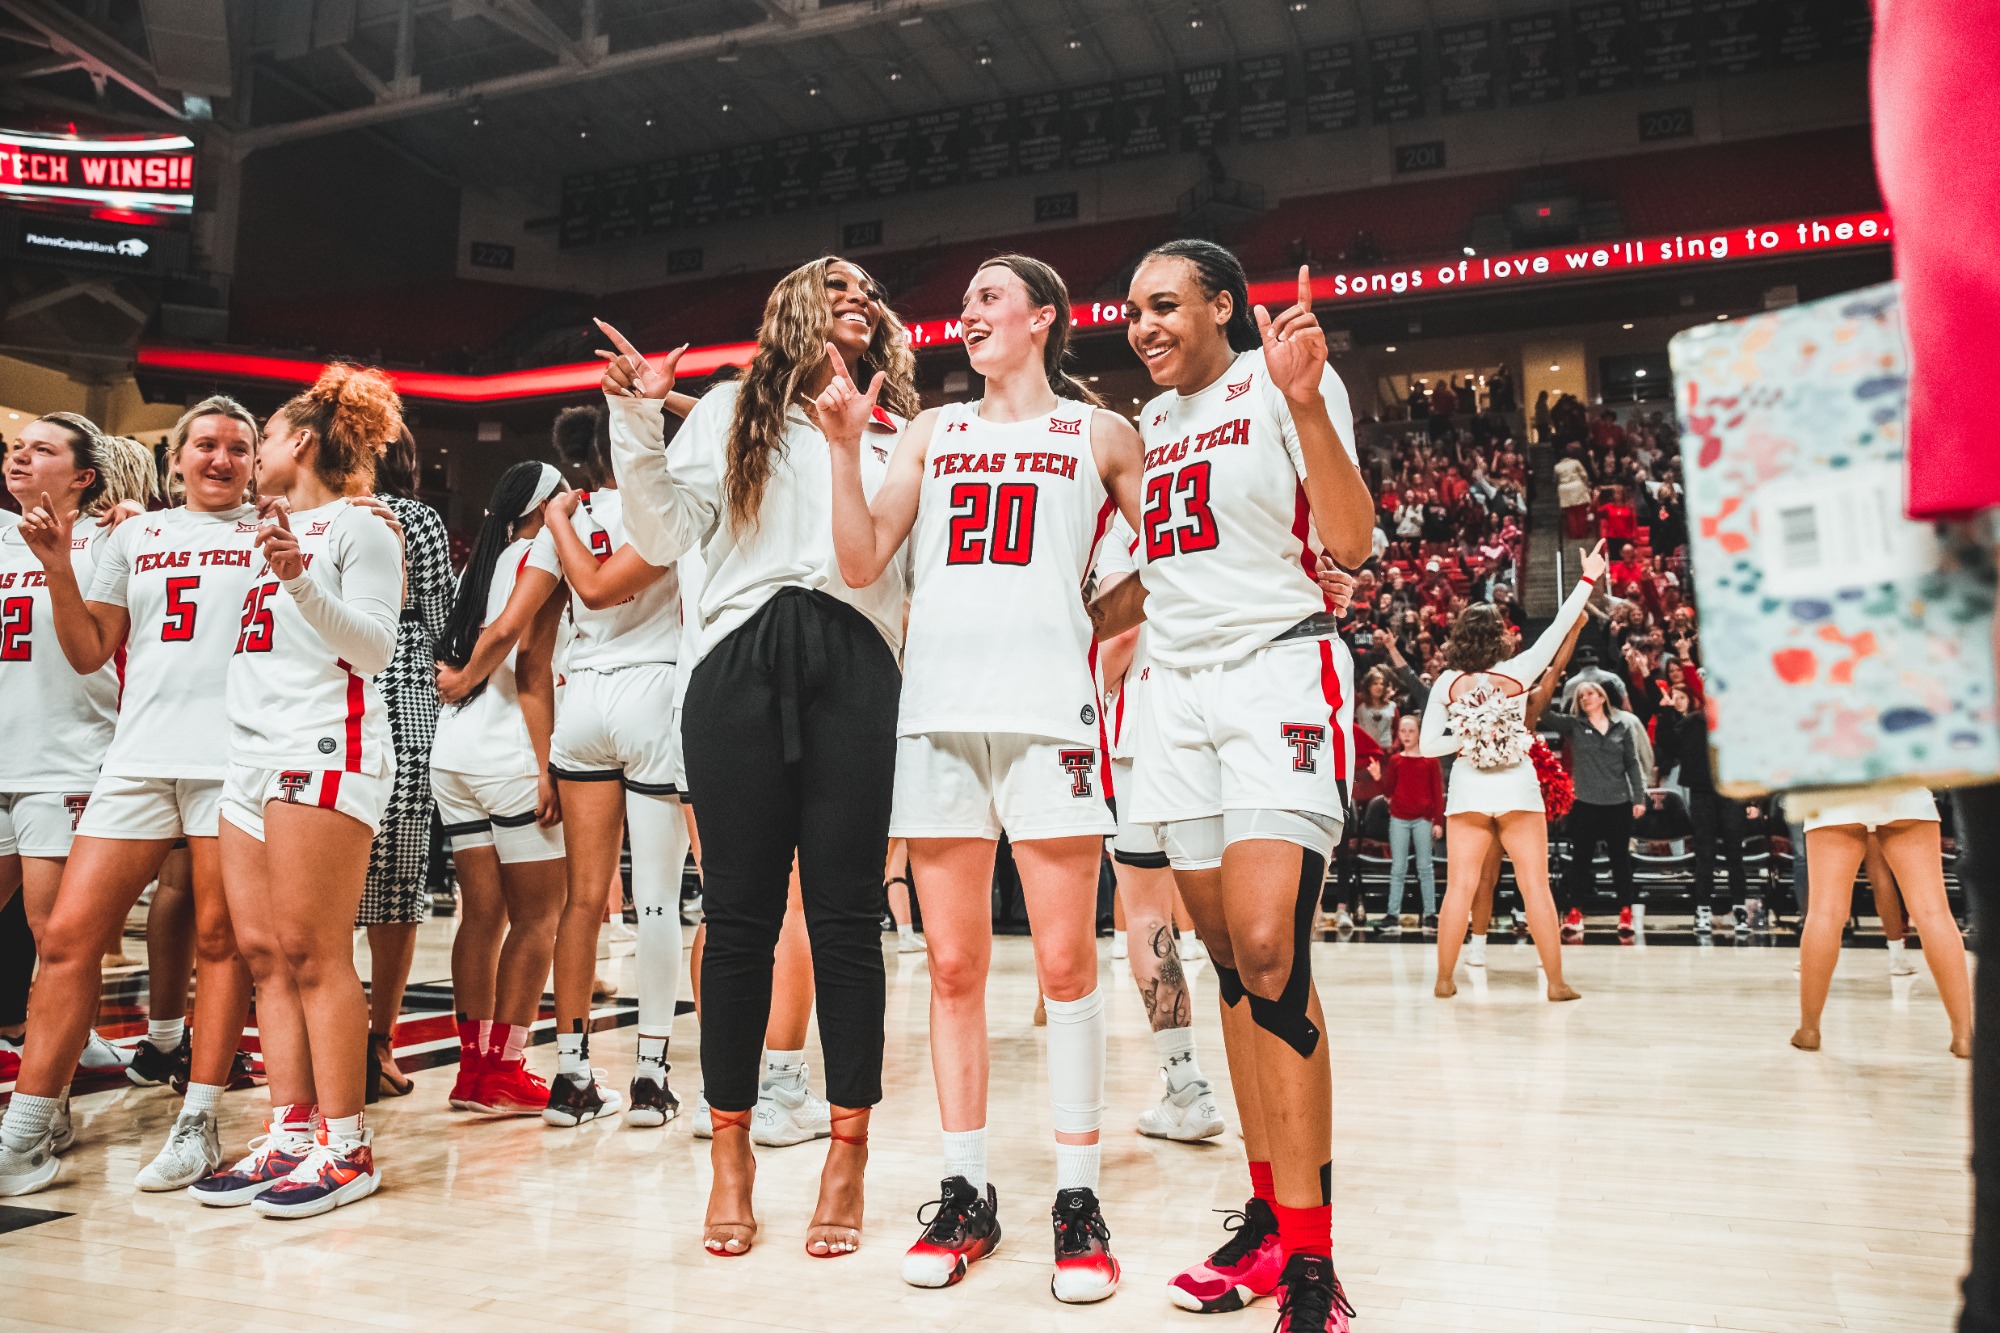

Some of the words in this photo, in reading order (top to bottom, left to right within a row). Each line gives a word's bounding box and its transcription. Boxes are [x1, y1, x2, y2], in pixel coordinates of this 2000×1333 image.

[1645, 113, 1687, 136] 202
[80, 155, 193, 188] WINS!!
[1405, 147, 1437, 168] 201
[1039, 199, 1073, 218] 232
[476, 246, 509, 265] 229
[1335, 270, 1423, 295] Songs
[1438, 261, 1468, 284] of
[1483, 258, 1550, 280] love
[1565, 241, 1644, 268] we'll
[1660, 236, 1728, 258] sing
[1745, 229, 1779, 250] to
[1797, 220, 1889, 244] thee,
[1194, 419, 1250, 452] TECH
[933, 453, 1006, 479] TEXAS
[1014, 452, 1078, 480] TECH
[946, 483, 1038, 566] 20
[1144, 460, 1220, 564] 23
[135, 551, 191, 575] TEXAS
[198, 550, 251, 567] TECH
[161, 575, 201, 642] 5
[233, 582, 280, 657] 25
[0, 596, 34, 661] 2
